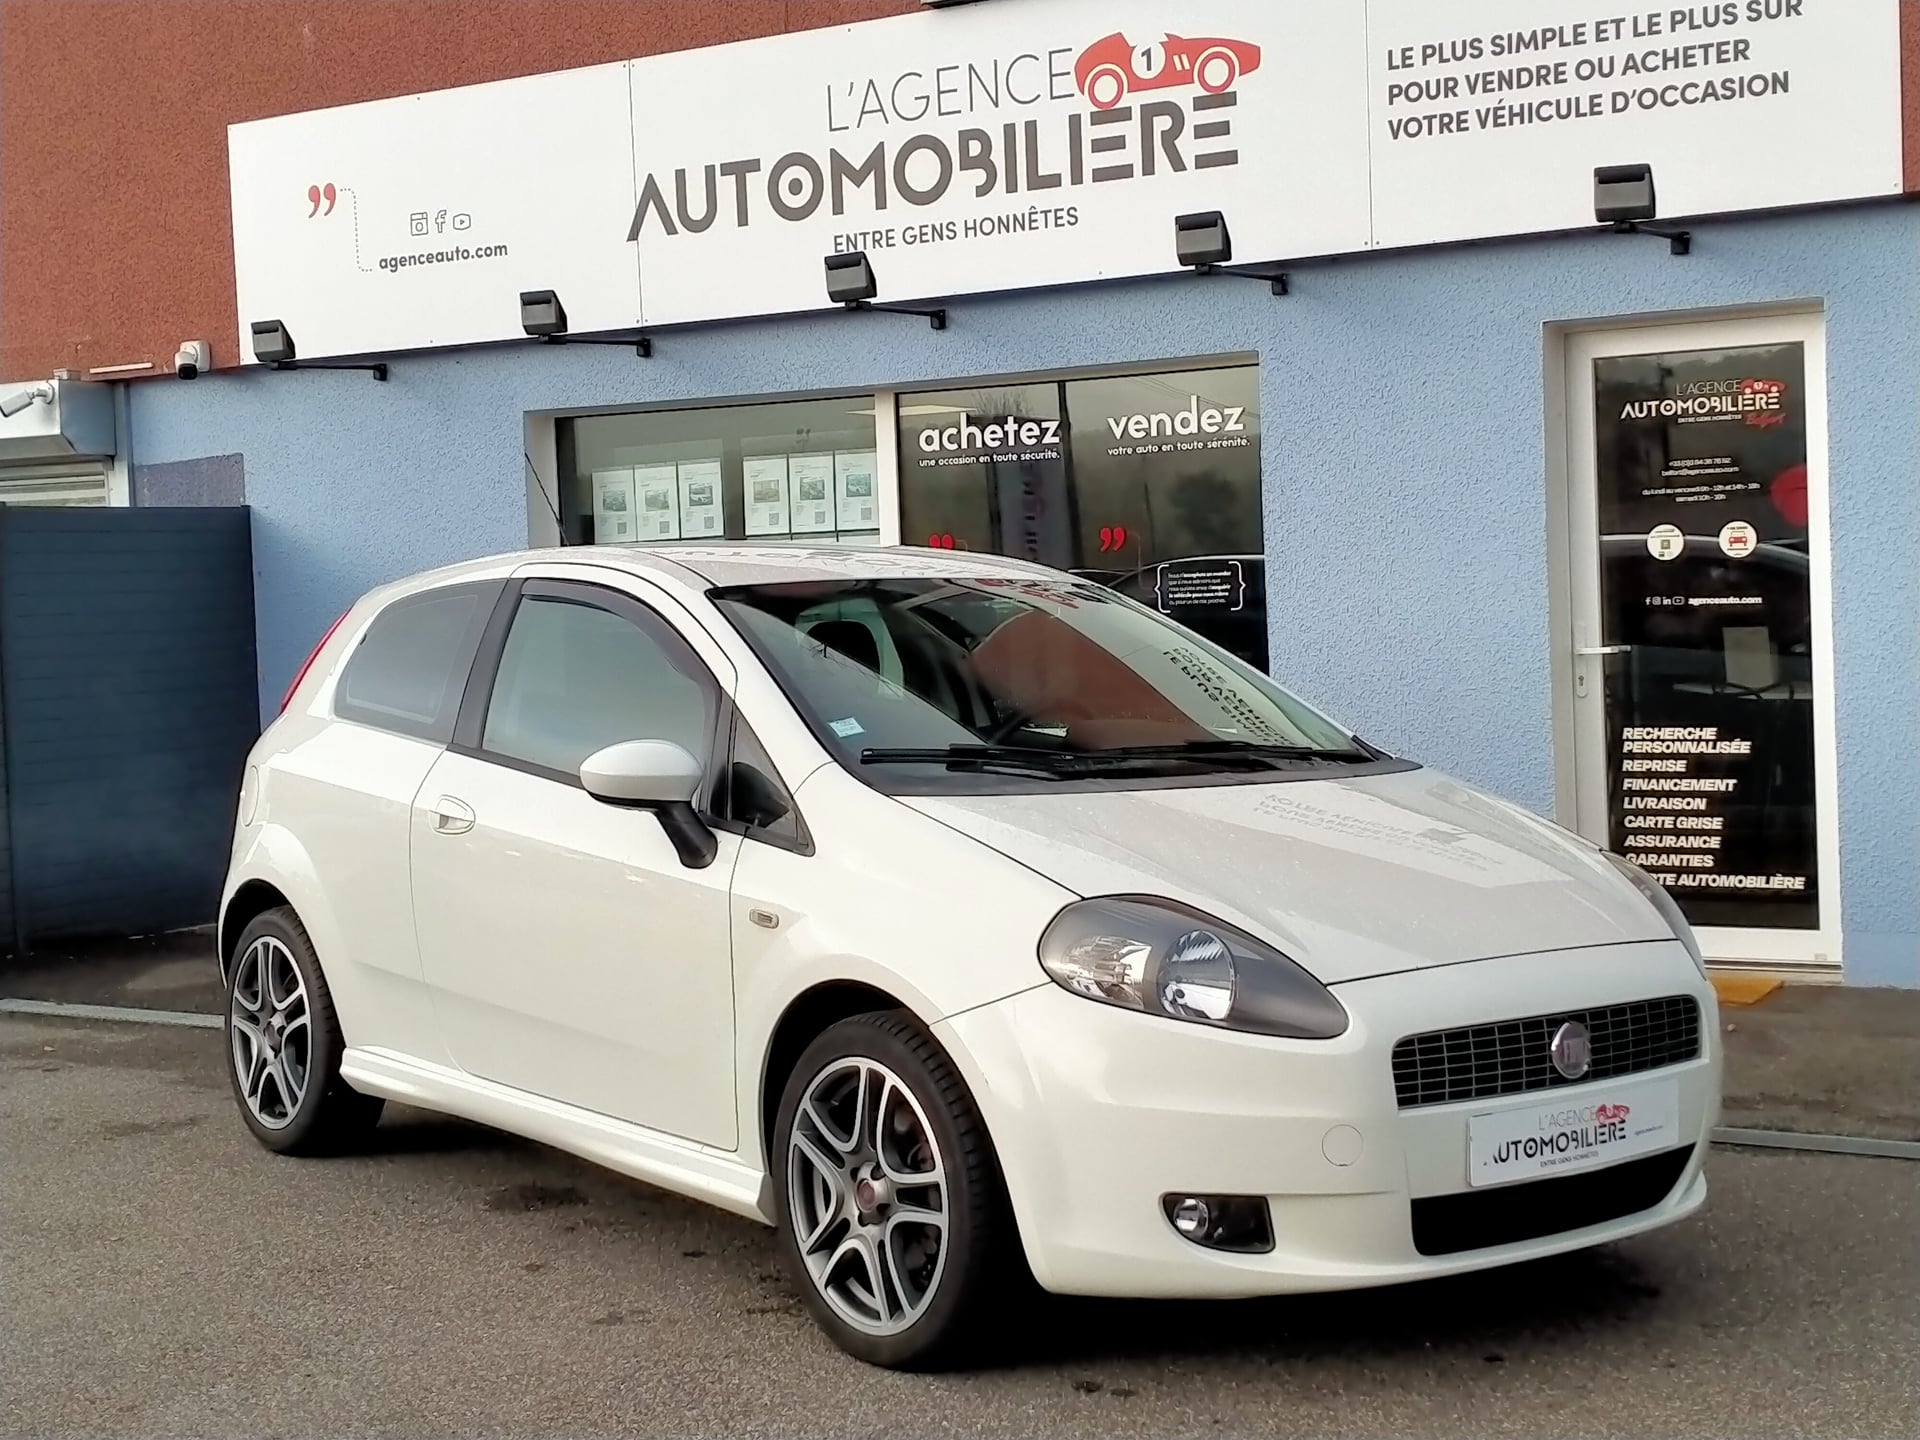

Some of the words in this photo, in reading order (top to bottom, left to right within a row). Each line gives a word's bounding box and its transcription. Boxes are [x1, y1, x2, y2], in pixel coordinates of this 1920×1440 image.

[1388, 46, 1414, 70] LE
[1421, 36, 1484, 67] PLUS
[1490, 22, 1587, 58] SIMPLE
[1594, 18, 1627, 43] ET
[1632, 13, 1662, 38] LE
[1670, 3, 1739, 33] PLUS
[1388, 78, 1459, 105] POUR
[1465, 62, 1568, 96] VENDRE
[1575, 55, 1615, 80] OU
[1621, 39, 1750, 76] ACHETER
[827, 47, 1075, 132] L'AGENCE
[1388, 111, 1470, 140] VOTRE
[1475, 92, 1603, 129] VÉHICULE
[1611, 70, 1790, 114] D'OCCASION
[833, 227, 896, 253] ENTRE
[901, 221, 957, 246] GENS
[964, 205, 1079, 240] HONNÊTES
[379, 243, 508, 273] agenceauto.com
[1107, 395, 1244, 440] vendez
[919, 412, 1060, 452] achetez
[1108, 447, 1133, 455] votre
[1136, 444, 1159, 454] auto
[1177, 441, 1204, 450] toute
[939, 455, 976, 466] occasion
[993, 454, 1017, 462] toute
[1622, 728, 1718, 740] RECHERCHE
[1623, 738, 1752, 754] PERSONNALISÉE
[1622, 760, 1687, 772] REPRISE
[1622, 779, 1737, 791] FINANCEMENT
[1623, 797, 1707, 810] LIVRAISON
[1624, 816, 1675, 829] CARTE
[1676, 817, 1724, 829] GRISE
[1624, 835, 1721, 848] ASSURANCE
[1625, 854, 1714, 867] GARANTIES
[1678, 873, 1805, 889] AUTOMOBILIÈRE
